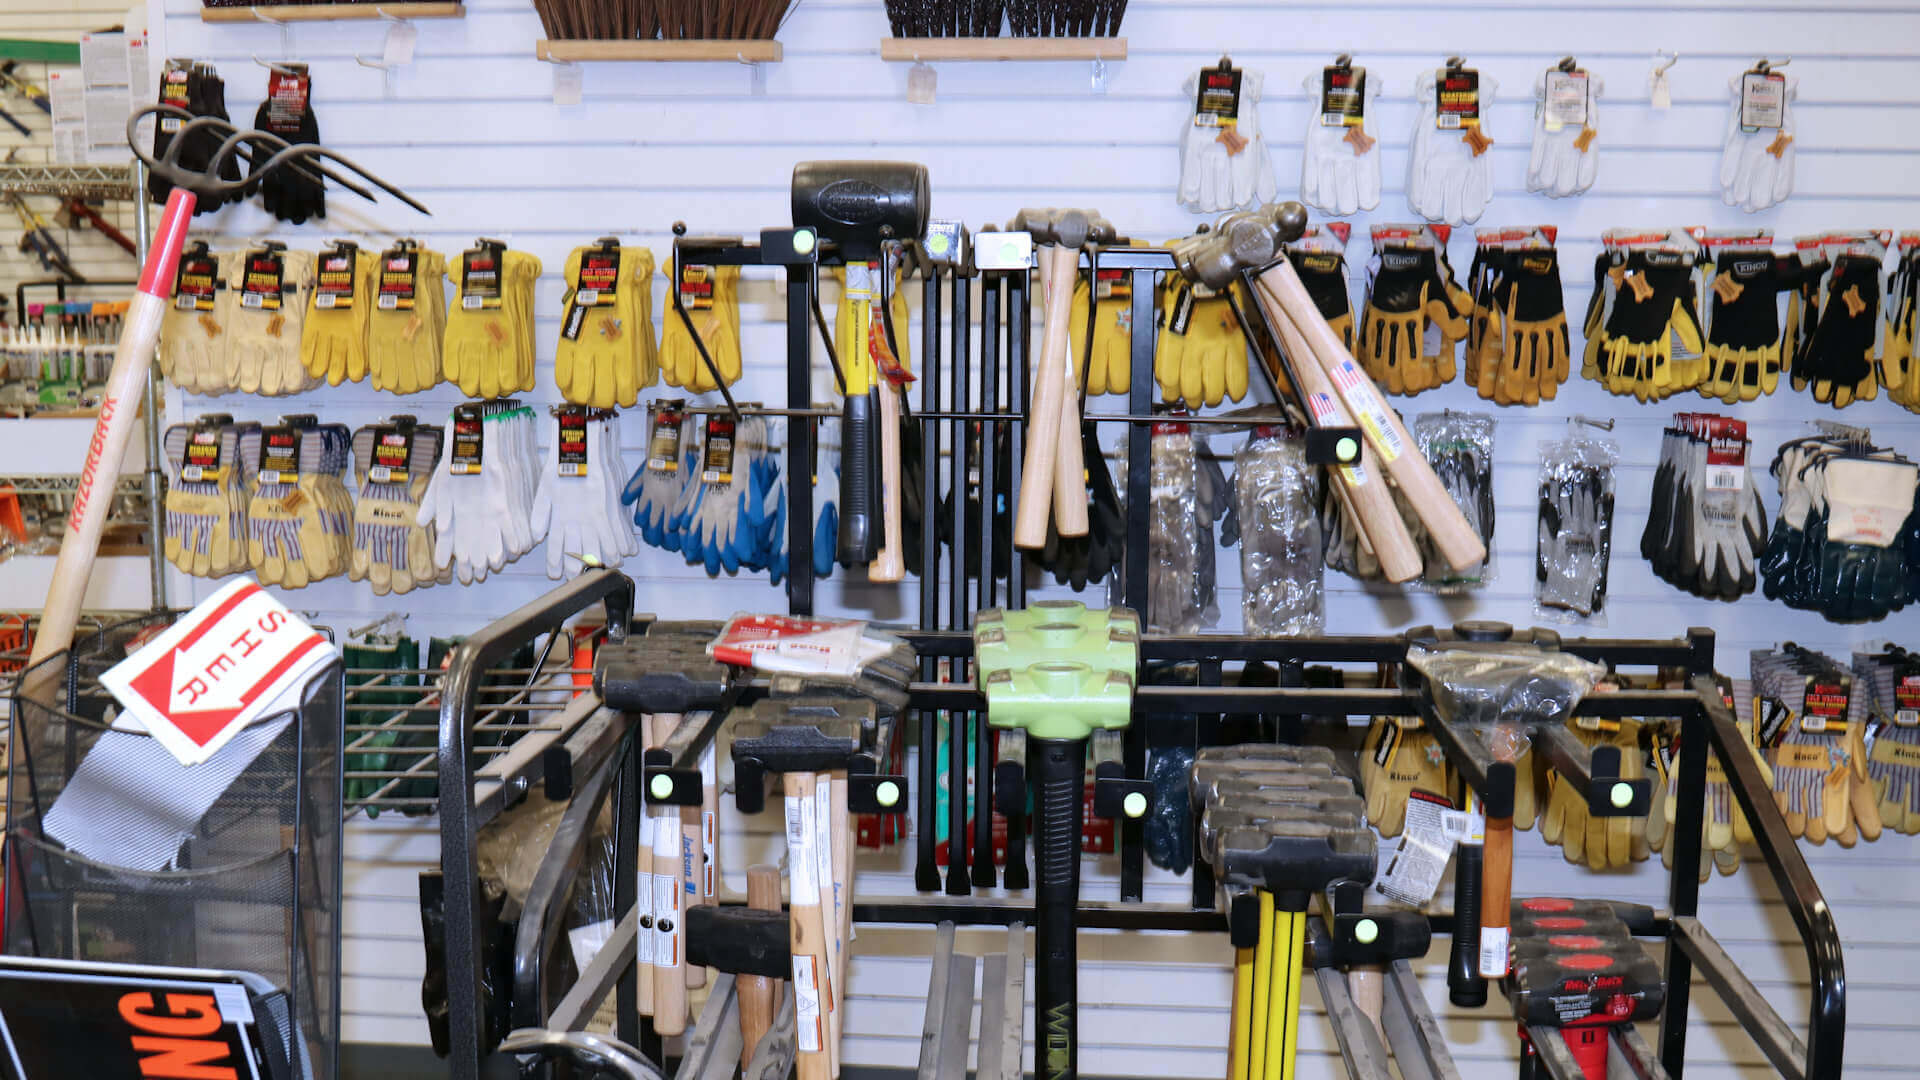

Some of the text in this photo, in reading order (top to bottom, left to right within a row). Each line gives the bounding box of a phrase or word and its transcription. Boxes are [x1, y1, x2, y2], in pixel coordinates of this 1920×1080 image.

[1739, 261, 1768, 273] KINCO
[68, 392, 118, 534] RAZORBACK
[177, 609, 292, 705] SHER
